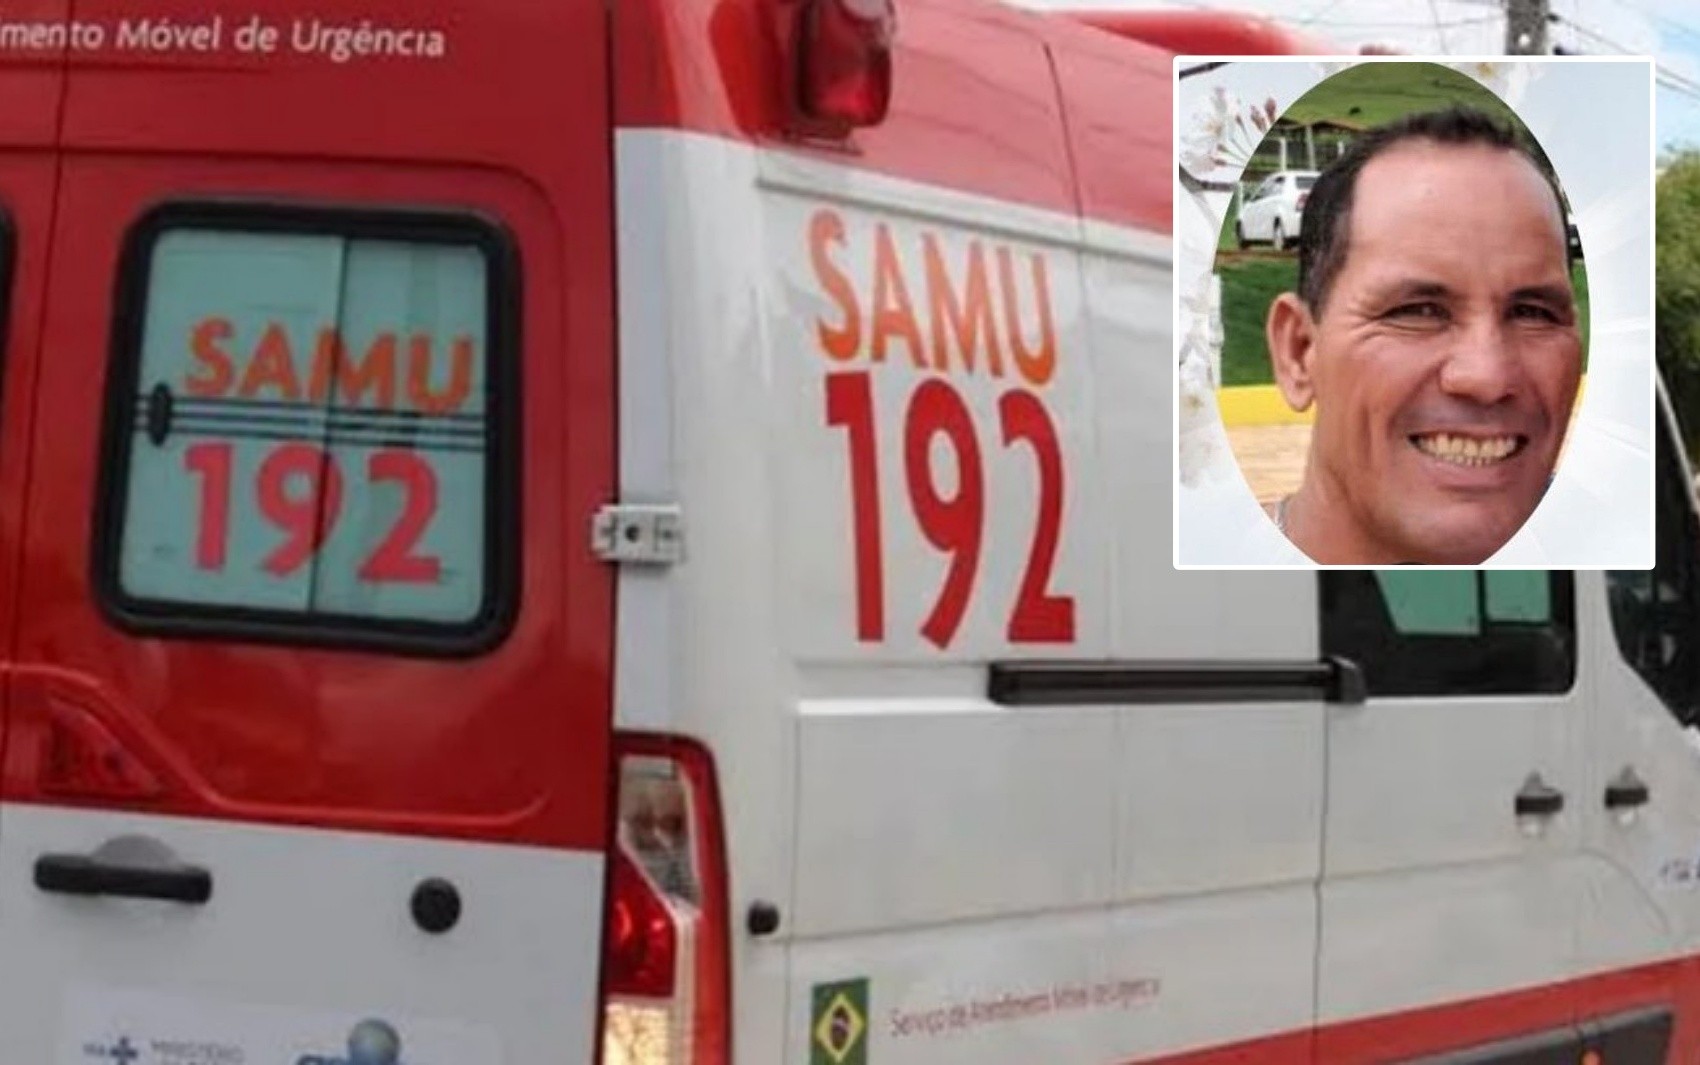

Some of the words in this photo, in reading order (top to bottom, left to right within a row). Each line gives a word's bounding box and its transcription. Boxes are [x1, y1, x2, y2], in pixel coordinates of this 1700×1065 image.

[0, 24, 105, 50] mento
[116, 15, 222, 51] Móvel
[233, 17, 278, 53] de
[291, 21, 445, 62] Urgência
[184, 317, 474, 415] SAMU
[807, 208, 1056, 386] SAMU
[183, 441, 440, 584] 192
[824, 371, 1075, 650] 192
